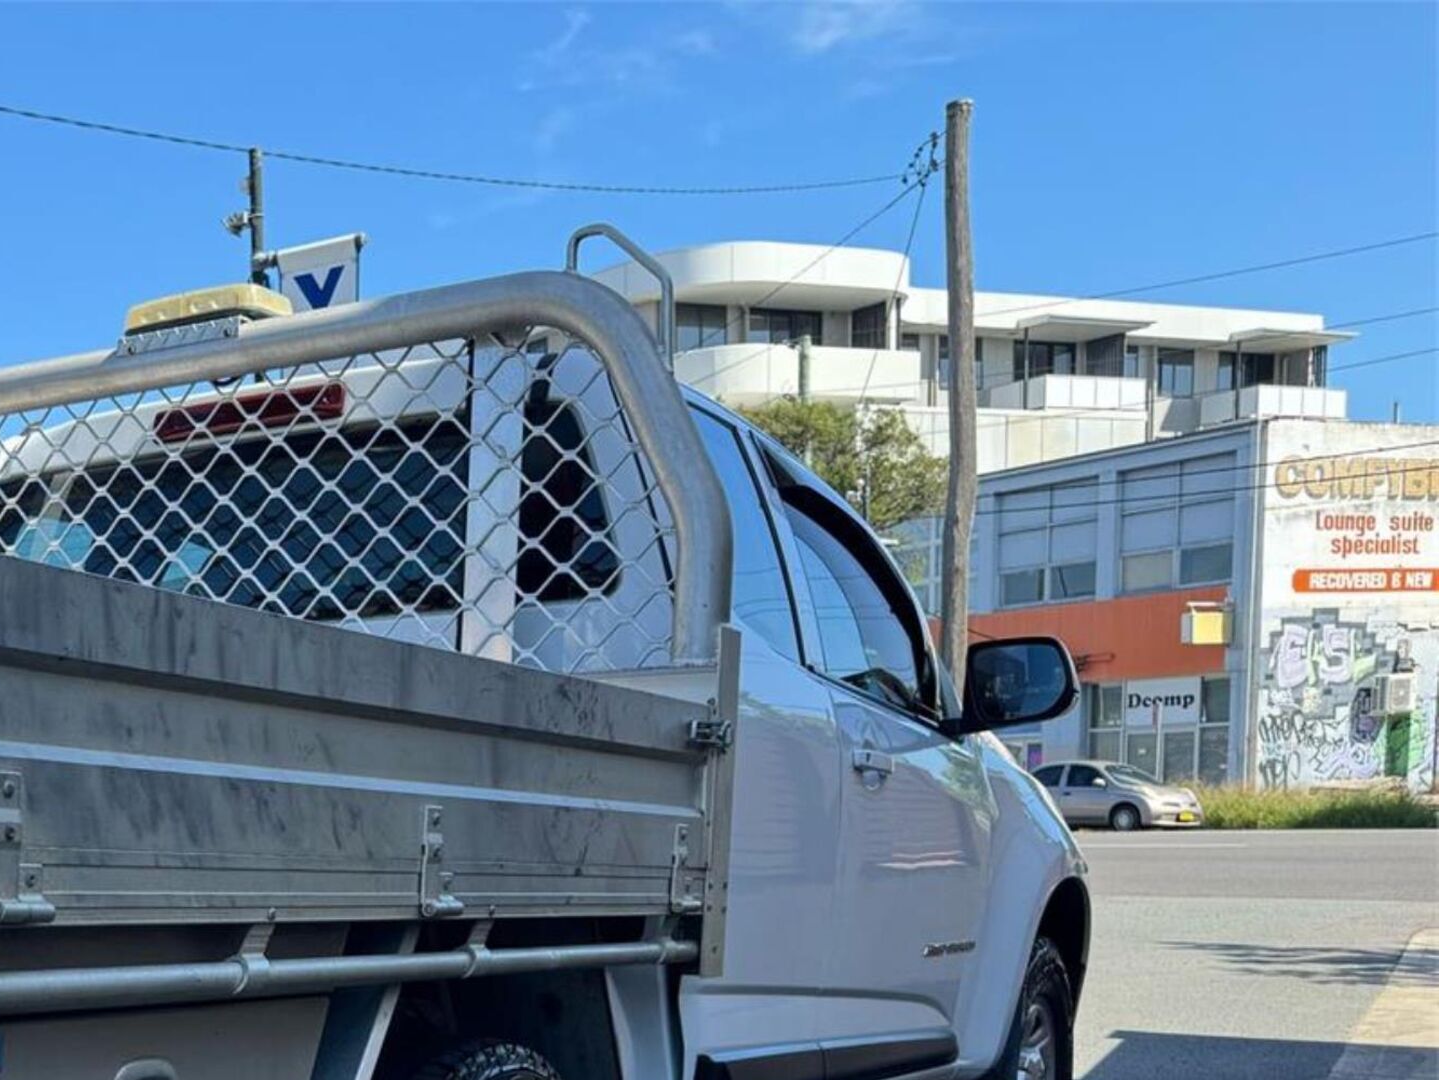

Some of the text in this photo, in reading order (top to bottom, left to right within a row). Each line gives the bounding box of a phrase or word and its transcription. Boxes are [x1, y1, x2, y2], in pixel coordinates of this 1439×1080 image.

[1316, 510, 1434, 536] Lounge suite
[1331, 533, 1421, 558] specialist
[1309, 571, 1387, 591] RECOVERED
[1406, 571, 1434, 589] NEW
